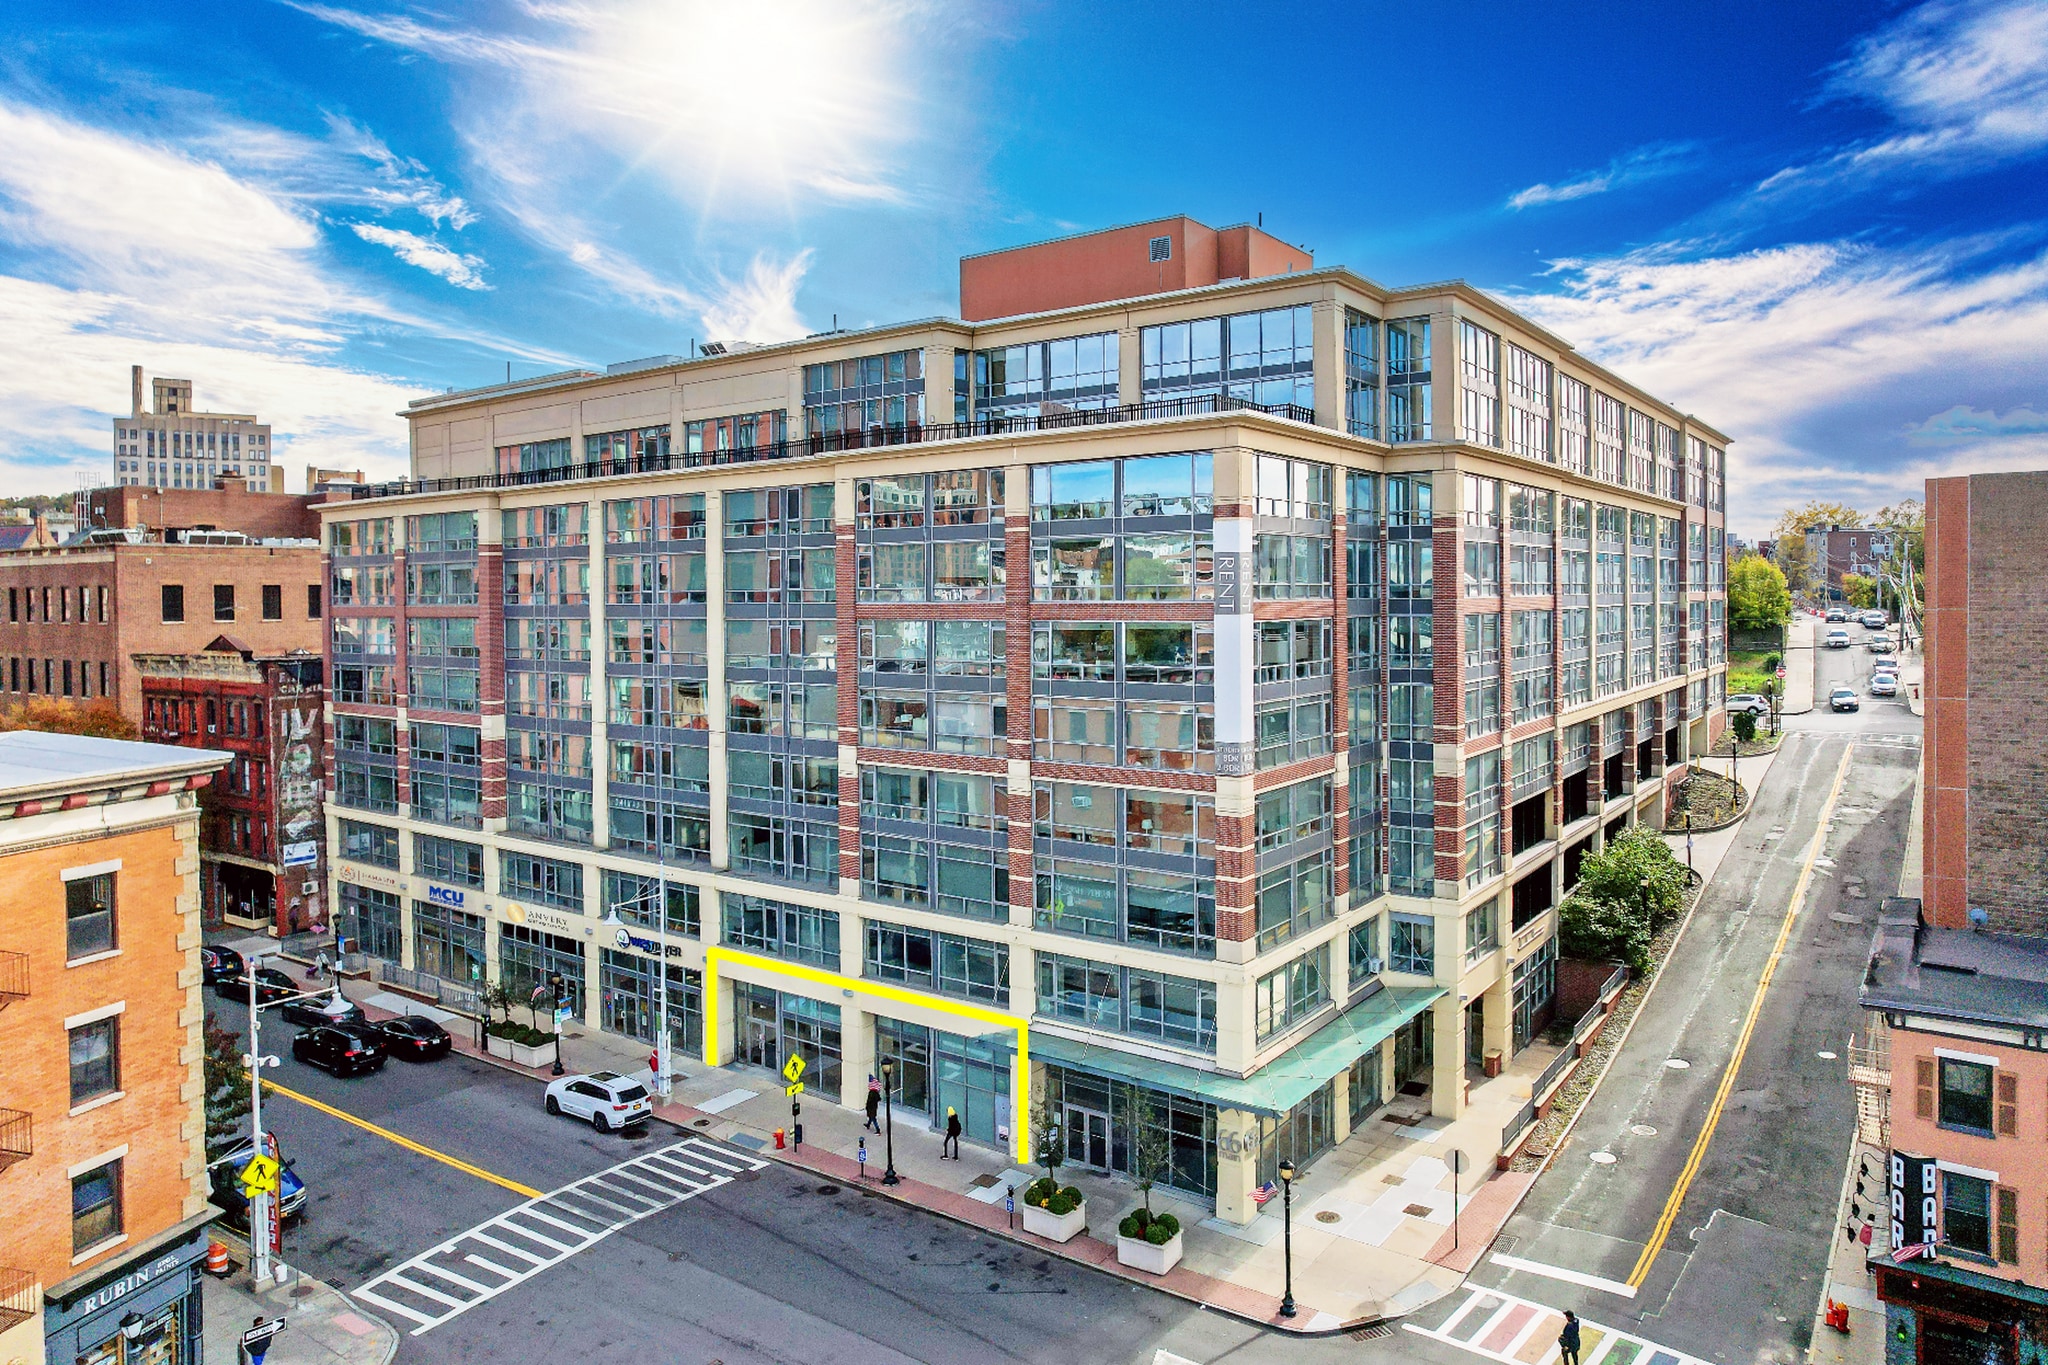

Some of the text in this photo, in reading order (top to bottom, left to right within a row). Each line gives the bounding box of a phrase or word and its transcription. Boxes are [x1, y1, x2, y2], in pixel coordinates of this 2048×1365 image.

[1218, 556, 1235, 612] RENT
[1241, 557, 1251, 612] RENT
[428, 884, 465, 904] MCU
[1892, 1155, 1905, 1253] BAR
[1922, 1163, 1937, 1259] BAR
[83, 1268, 150, 1315] RUBIN
